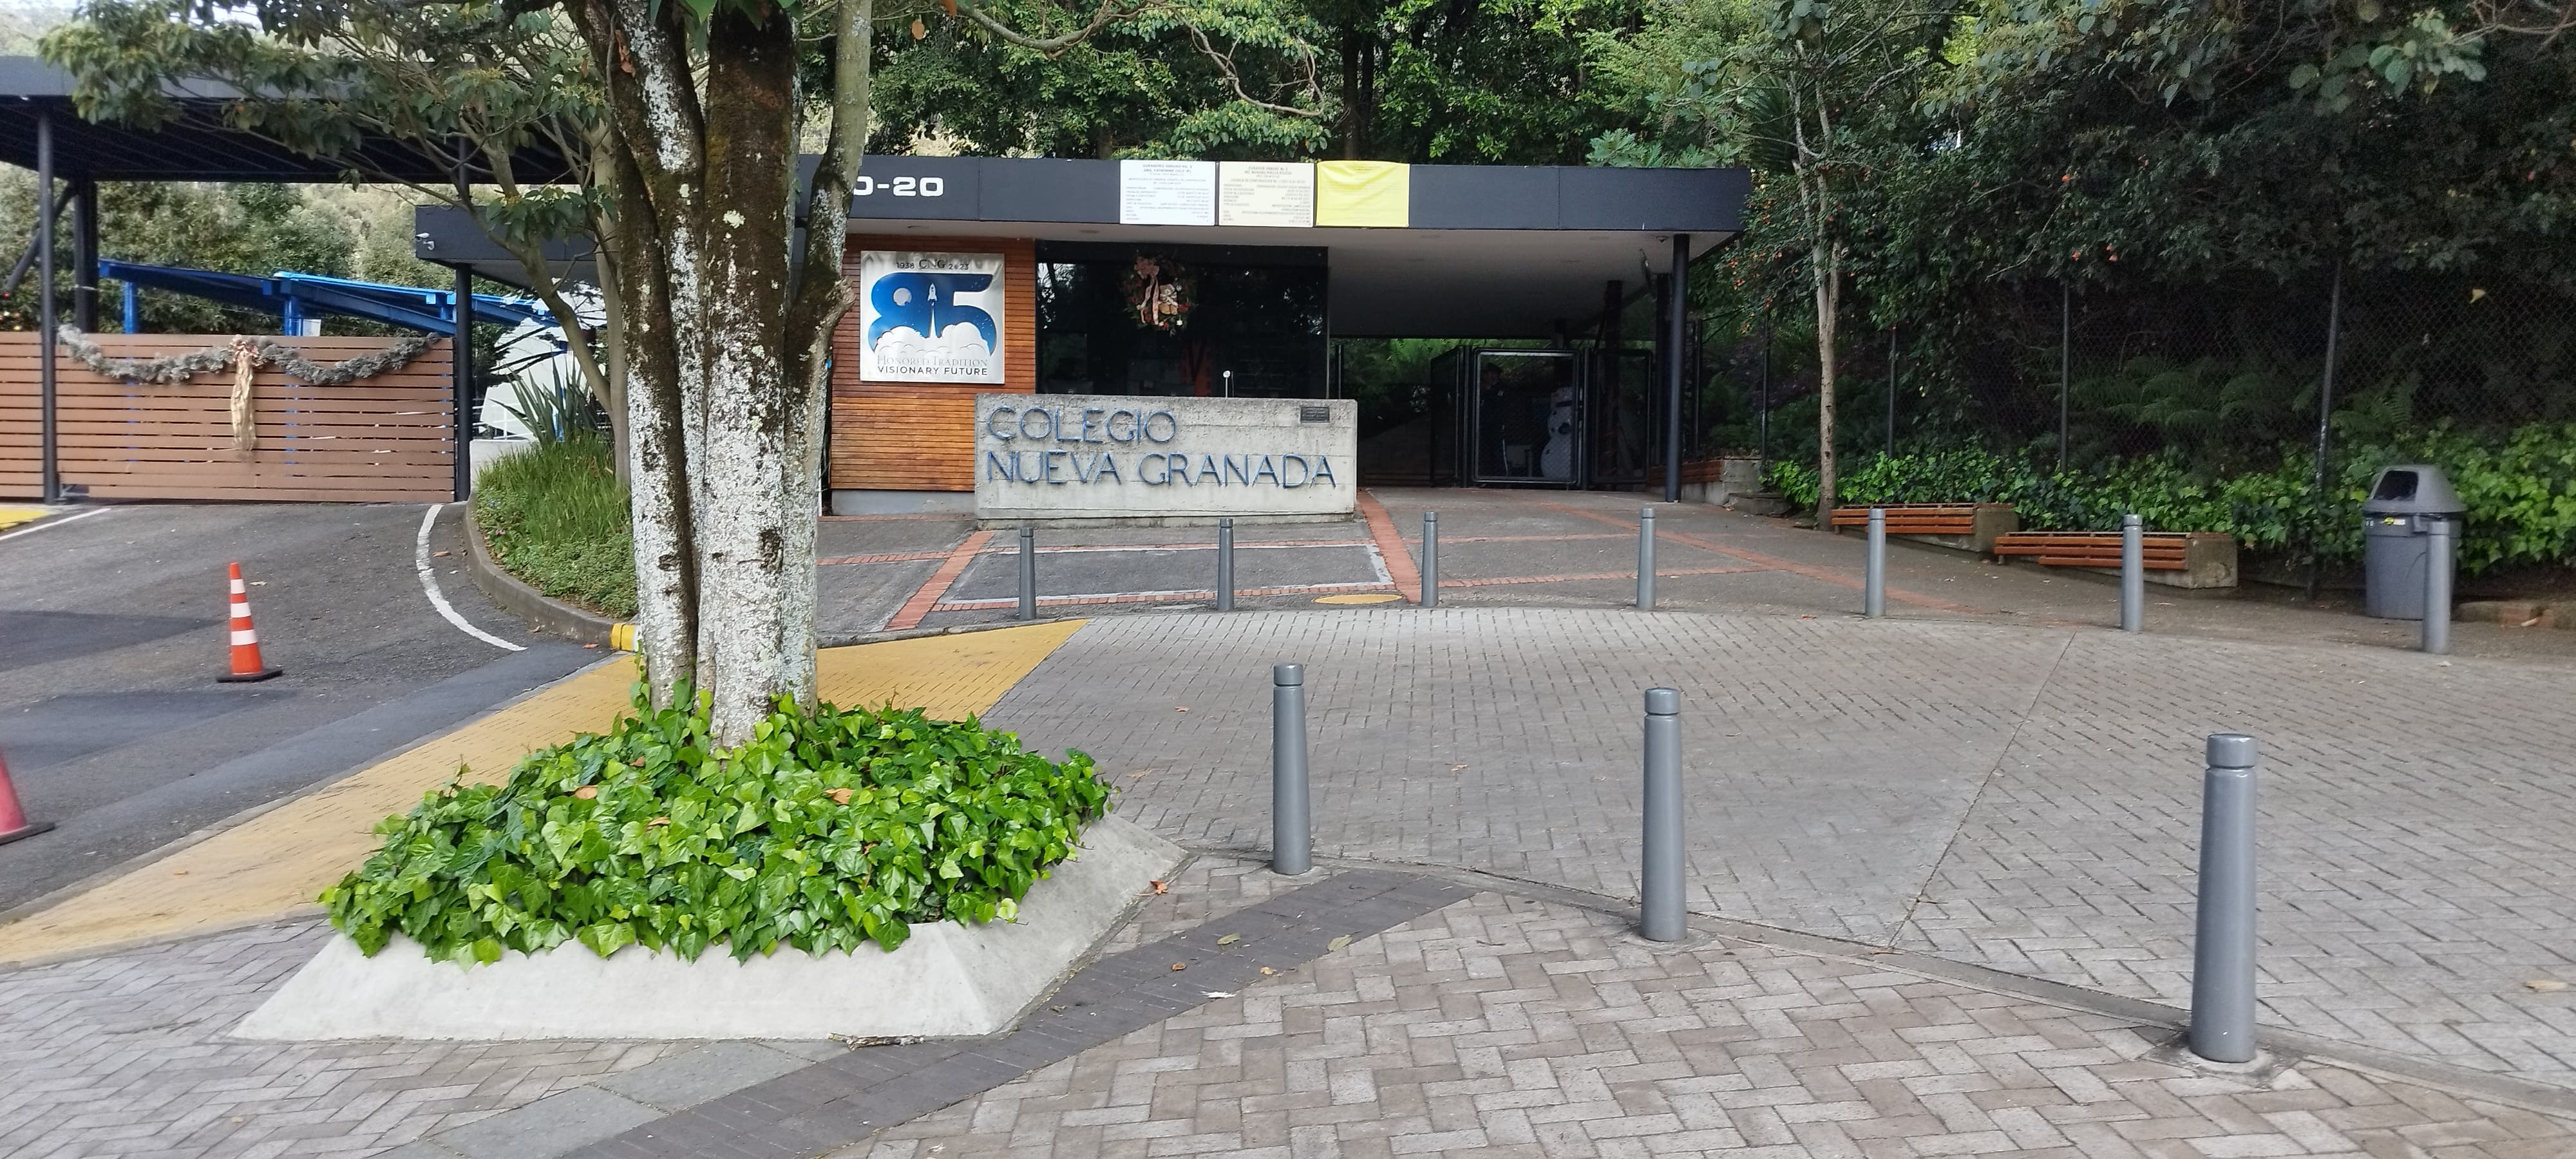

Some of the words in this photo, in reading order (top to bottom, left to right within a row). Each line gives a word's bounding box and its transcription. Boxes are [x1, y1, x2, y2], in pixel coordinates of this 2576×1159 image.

[919, 259, 946, 269] CNG
[868, 272, 997, 357] 85
[878, 366, 939, 375] VISIONARY
[944, 367, 988, 375] FUTURE
[987, 406, 1177, 444] COLEGIO
[987, 449, 1122, 485] NUEVA
[1138, 453, 1337, 489] GRANADA
